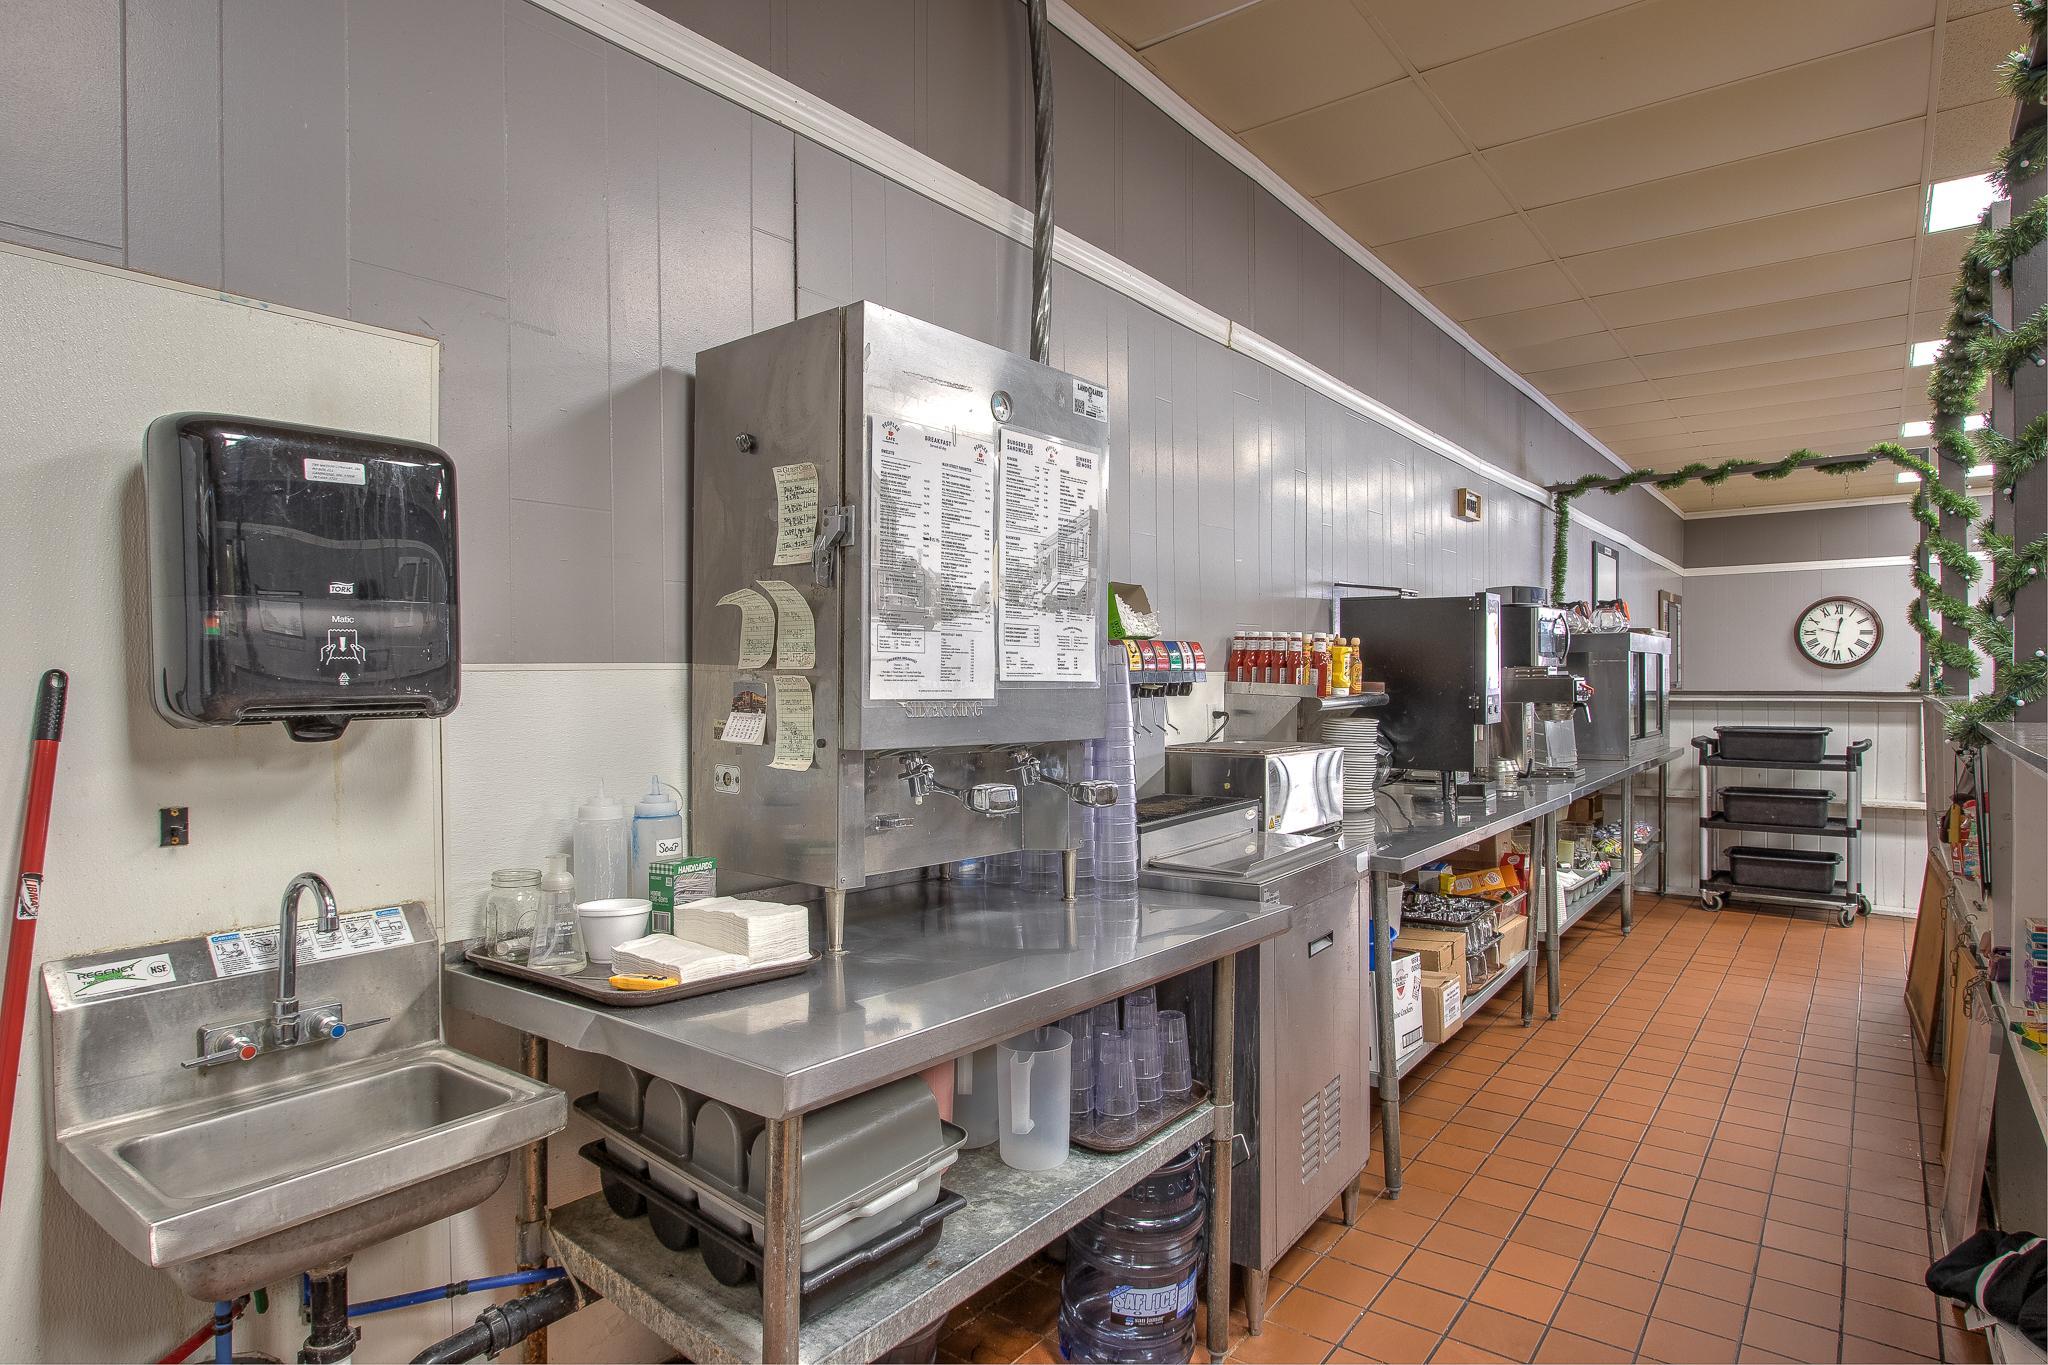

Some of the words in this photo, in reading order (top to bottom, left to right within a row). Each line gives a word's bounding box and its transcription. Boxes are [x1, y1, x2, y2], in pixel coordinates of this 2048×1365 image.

[924, 435, 952, 447] BREAKFAST
[1006, 438, 1027, 449] BURGERS
[1006, 444, 1034, 456] SANDWICHES
[1075, 455, 1092, 464] DINNERS
[1080, 461, 1092, 470] MORE
[331, 585, 352, 593] TORK
[331, 615, 355, 624] Matic
[952, 700, 984, 718] KING
[76, 963, 135, 981] REGENCY
